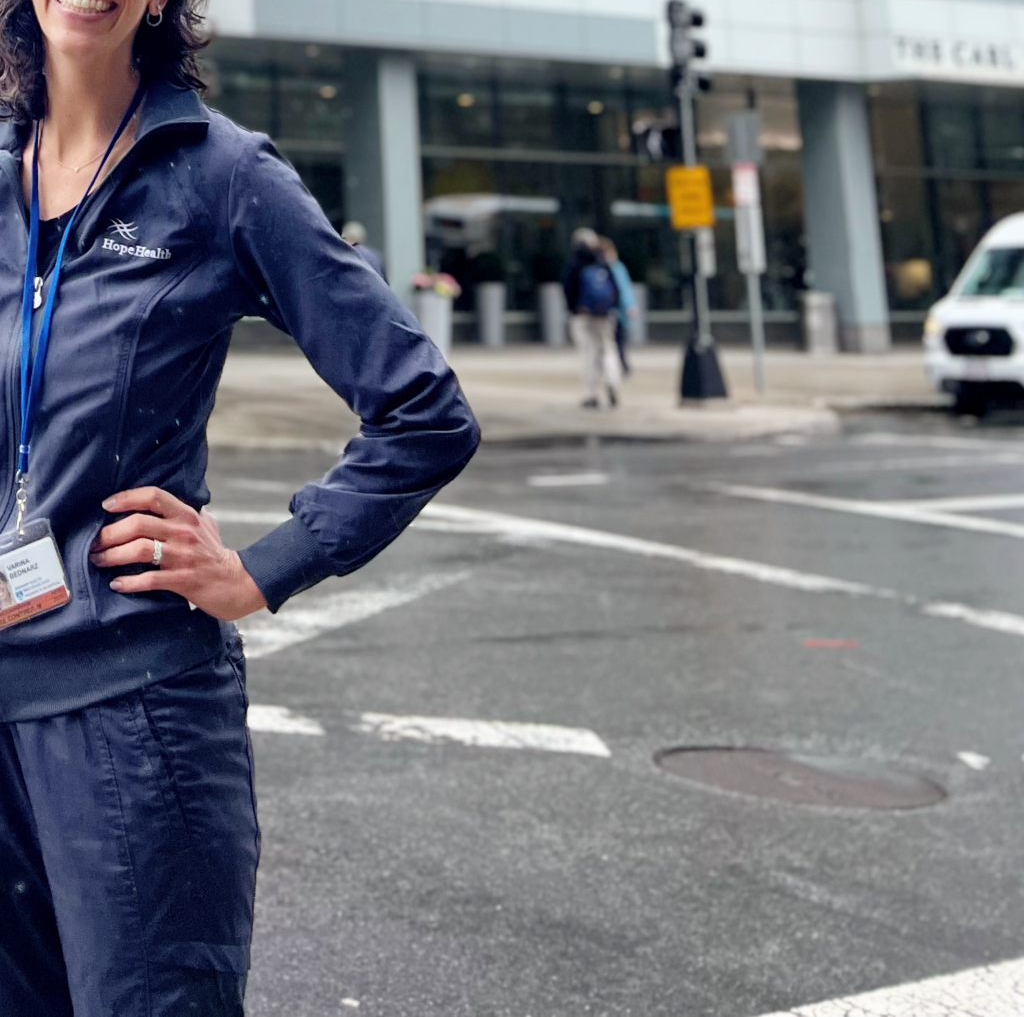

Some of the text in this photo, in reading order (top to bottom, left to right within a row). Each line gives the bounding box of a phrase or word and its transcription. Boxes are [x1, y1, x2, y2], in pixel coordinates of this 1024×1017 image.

[895, 35, 1016, 71] THE CARL
[102, 238, 172, 260] HopeHealth
[7, 558, 30, 571] VARINA
[9, 562, 38, 579] BEDNARZ
